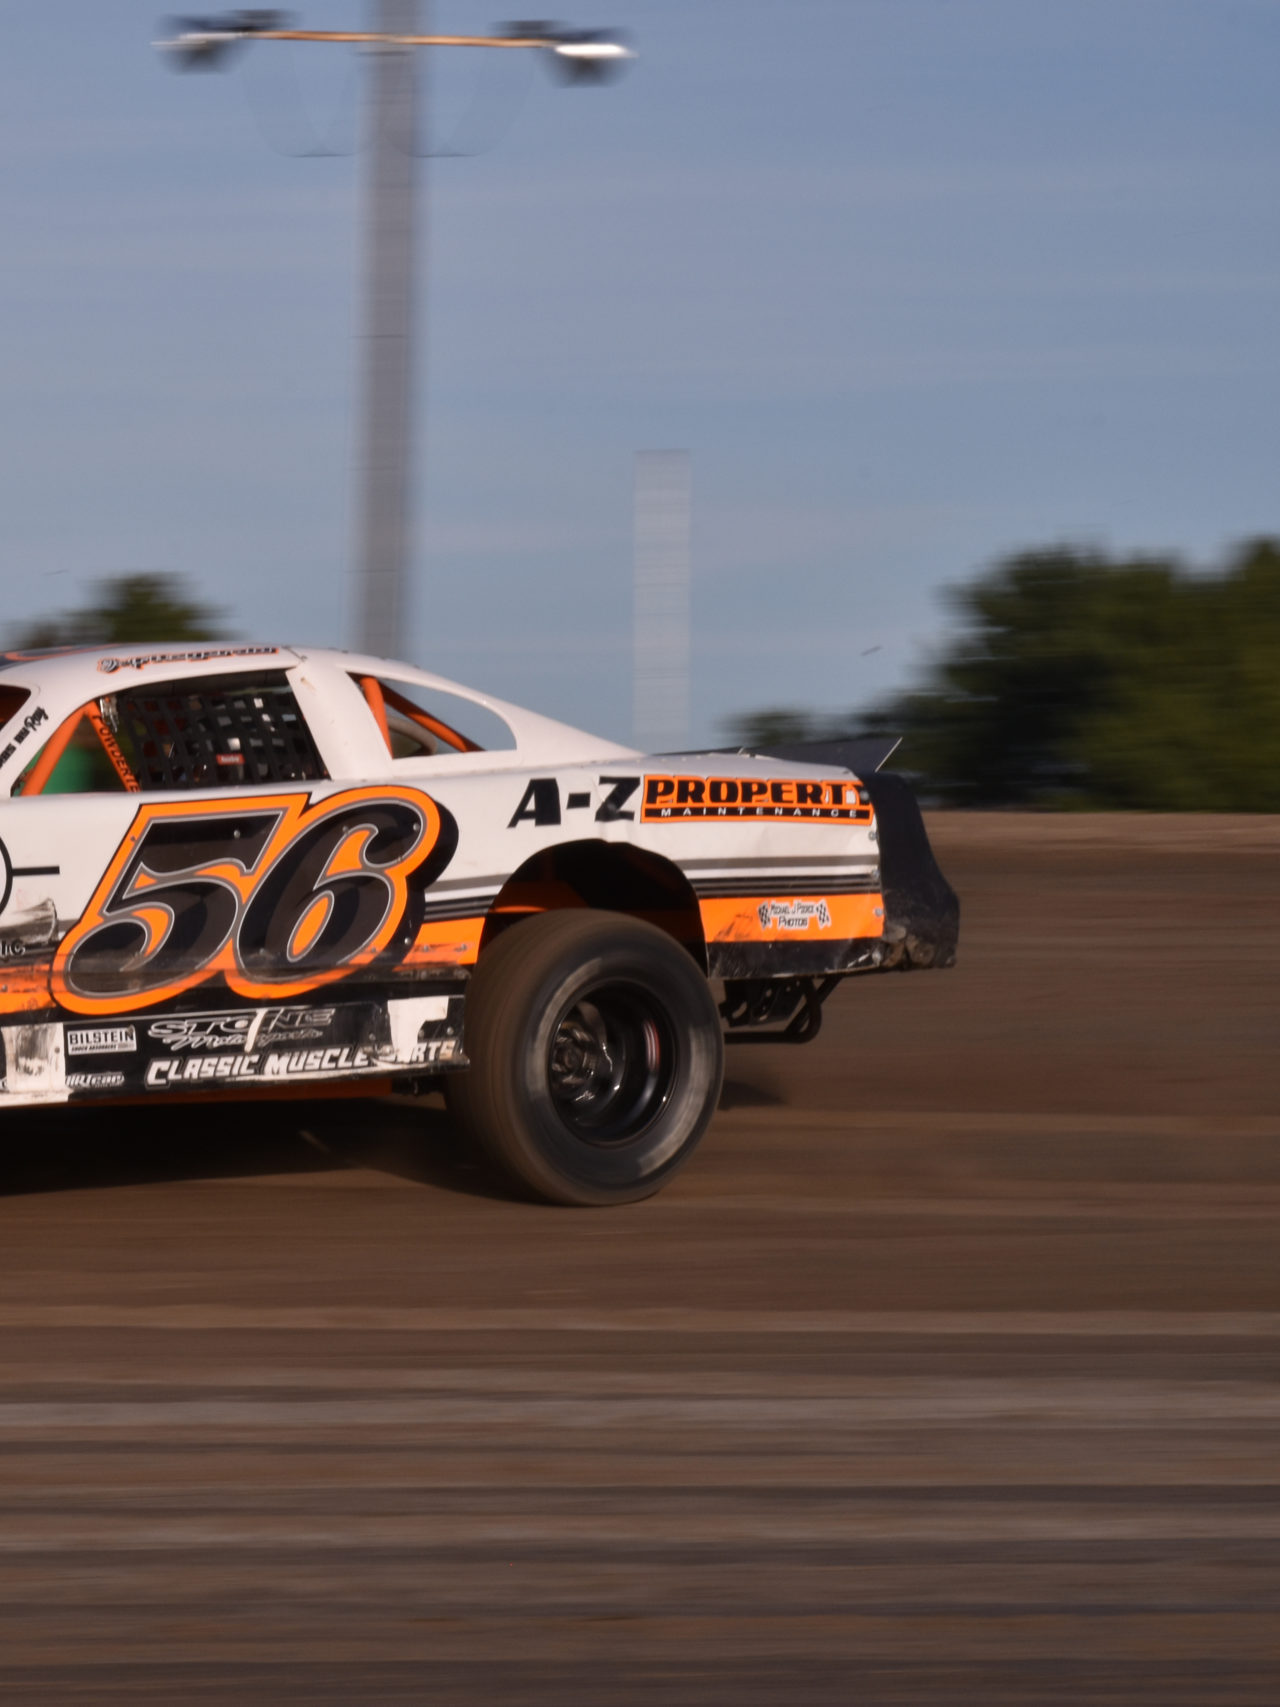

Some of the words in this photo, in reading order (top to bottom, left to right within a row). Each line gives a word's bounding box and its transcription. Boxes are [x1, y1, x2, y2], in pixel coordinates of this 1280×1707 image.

[506, 775, 641, 829] A-Z
[660, 807, 858, 818] MAINTENANCE
[51, 785, 458, 1014] 56
[69, 1029, 135, 1046] BILSTEIN
[147, 1054, 259, 1085] CLASSIC
[264, 1045, 369, 1075] MUSCLE
